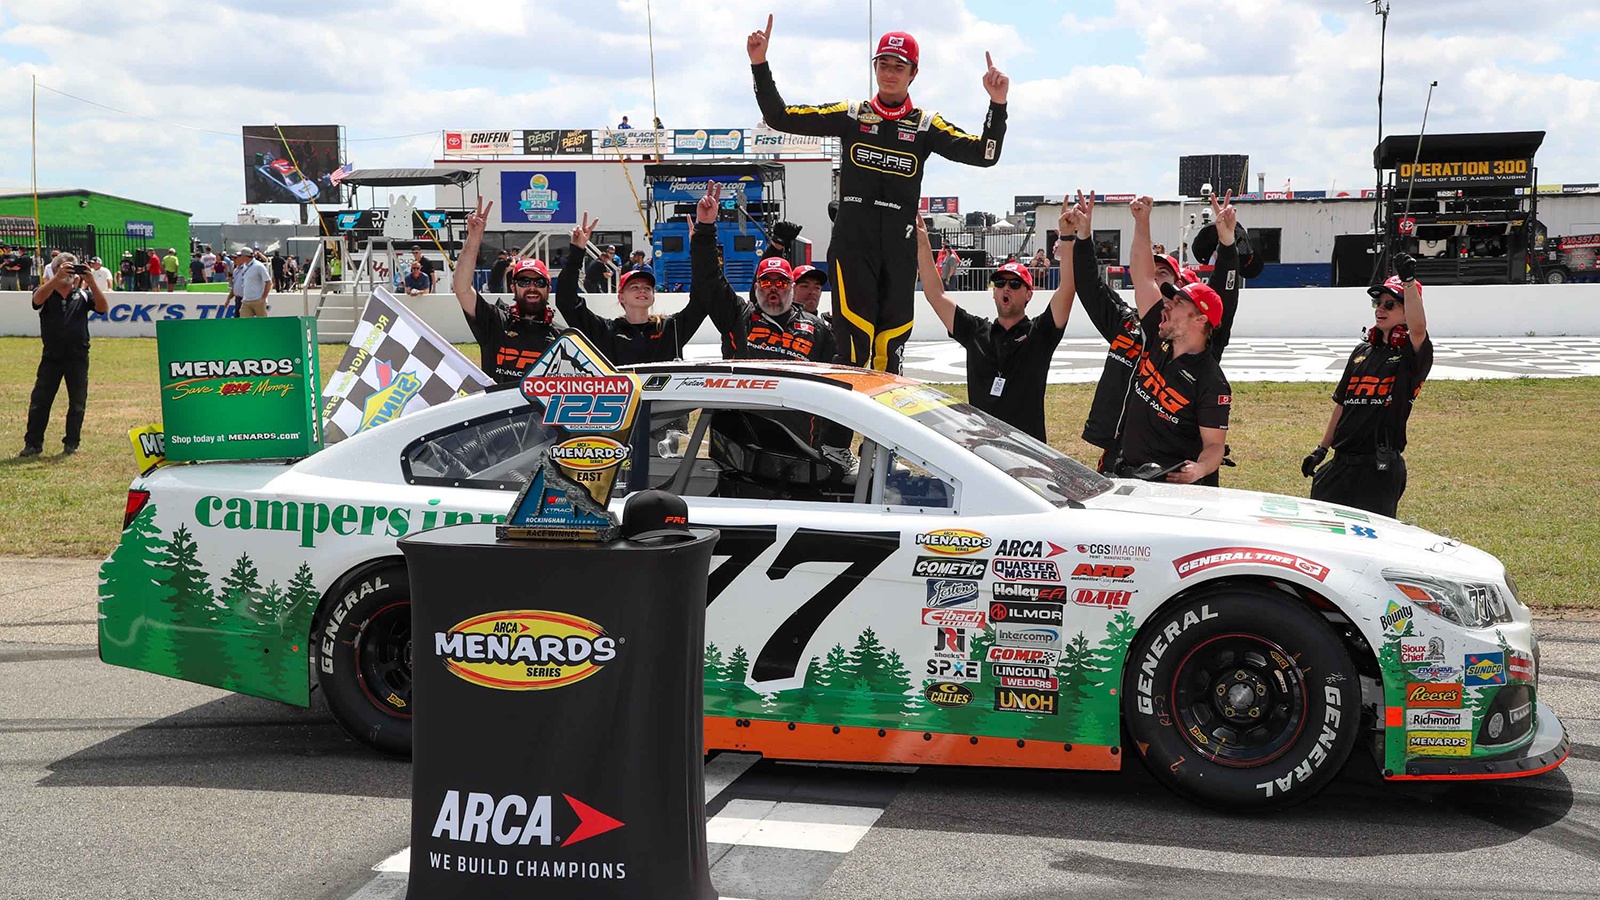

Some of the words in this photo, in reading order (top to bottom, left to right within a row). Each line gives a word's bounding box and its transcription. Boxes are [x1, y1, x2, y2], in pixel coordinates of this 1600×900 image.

[470, 132, 509, 144] GRIFFIN
[527, 131, 556, 147] BEAST
[562, 134, 588, 149] BEAST
[857, 148, 912, 168] SPIRE
[1400, 161, 1490, 182] OPERATION
[1493, 159, 1527, 174] 300
[531, 200, 548, 208] 250
[747, 327, 813, 356] PRG
[170, 359, 294, 377] MENARDS
[172, 383, 214, 400] Save
[252, 379, 292, 397] Money
[523, 380, 629, 394] ROCKINGHAM
[703, 378, 779, 390] MCKEE
[541, 394, 629, 425] 125
[171, 435, 191, 444] Shop
[193, 434, 214, 443] today
[228, 433, 299, 441] MENARDS.com
[552, 447, 625, 459] MENARDS
[577, 471, 603, 481] EAST
[194, 494, 411, 549] campers
[665, 516, 687, 524] PRG
[526, 530, 547, 538] RACE
[547, 530, 581, 538] WINNER
[915, 534, 992, 548] MENARDS
[995, 539, 1043, 558] ARCA
[916, 561, 985, 576] COMETIC
[995, 560, 1055, 573] QUARTER
[1071, 563, 1136, 578] ARP
[1178, 552, 1253, 574] GENERAL
[1252, 552, 1294, 565] TIRE
[1005, 569, 1057, 580] MASTER
[927, 580, 979, 607] Jostens
[994, 583, 1039, 601] Holley
[1468, 587, 1490, 625] 77
[923, 609, 983, 625] Eibach
[1008, 608, 1062, 621] ILMOR
[1379, 604, 1414, 632] Bounty
[321, 576, 390, 675] GENERAL
[493, 621, 518, 634] ARCA
[999, 630, 1053, 643] Intercomp
[434, 631, 617, 664] MENARDS
[990, 648, 1043, 661] COMP
[1401, 644, 1426, 653] Sioux
[1137, 604, 1219, 716] GENERAL
[1401, 653, 1425, 662] Chief
[526, 666, 561, 678] SERIES
[996, 666, 1047, 678] LINCOLN
[1467, 663, 1503, 676] SUNOCO
[1007, 678, 1052, 689] WELDERS
[930, 691, 970, 704] CALLIES
[1000, 691, 1054, 711] UNOH
[1408, 686, 1459, 702] Reese's
[1413, 713, 1461, 726] Richmond
[1255, 685, 1342, 798] GENERAL
[1410, 737, 1468, 747] MENARDS
[431, 789, 552, 846] ARCA
[430, 851, 451, 870] WE
[457, 855, 508, 876] BUILD
[516, 859, 626, 880] CHAMPIONS
